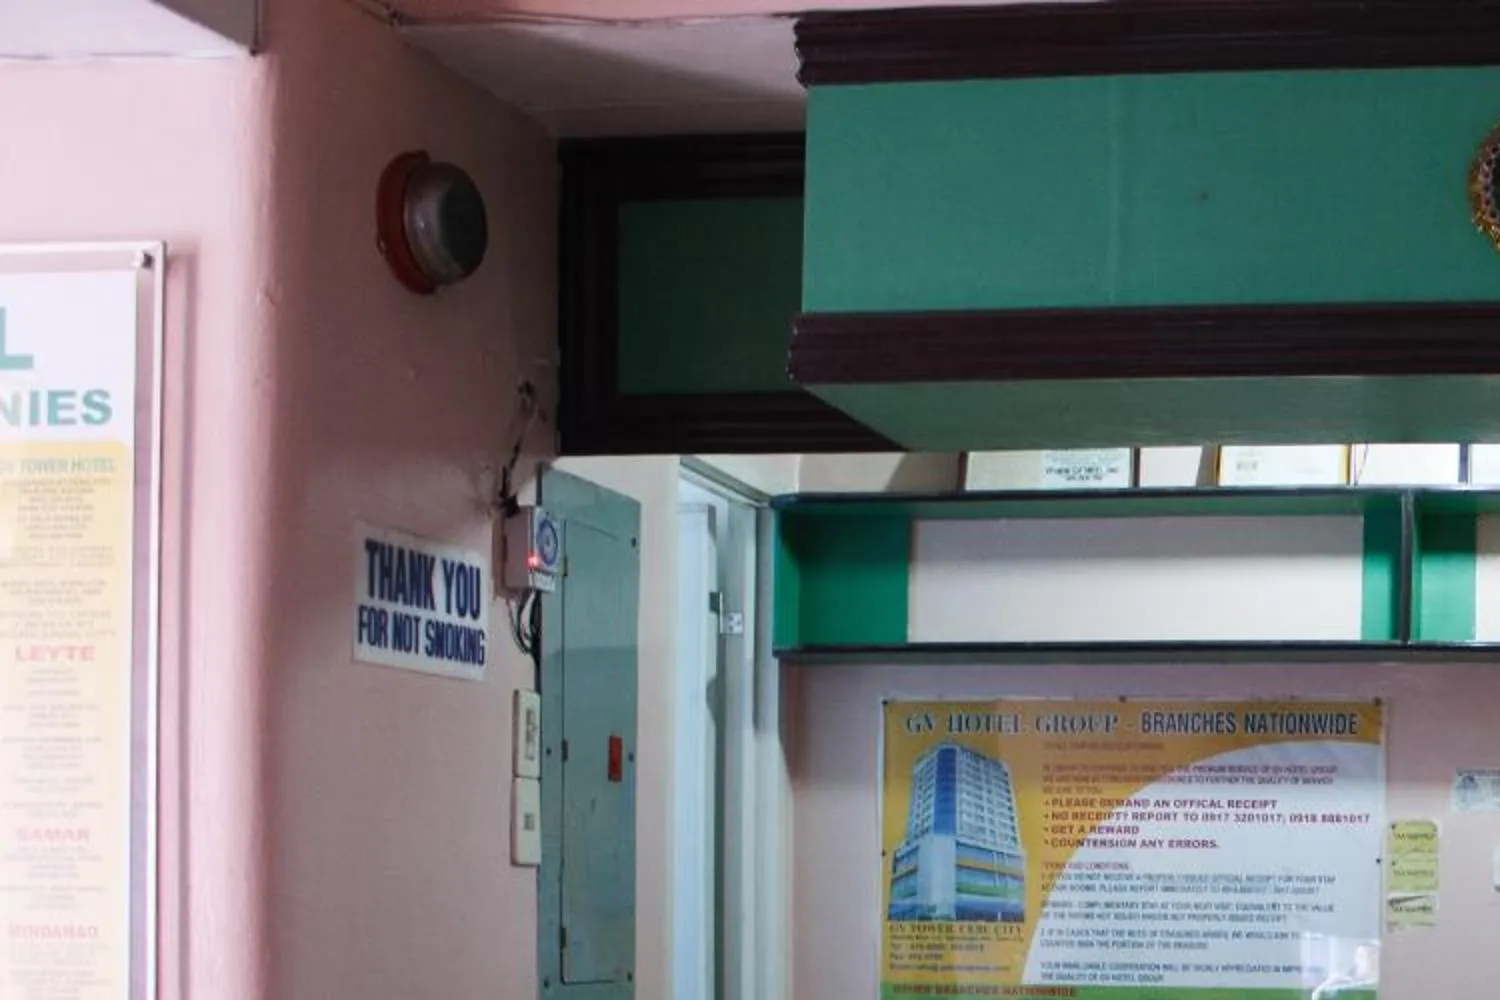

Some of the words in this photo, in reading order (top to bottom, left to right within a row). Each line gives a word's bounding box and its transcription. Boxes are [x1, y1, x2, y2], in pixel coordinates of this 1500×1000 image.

[365, 536, 436, 612] THANK
[441, 557, 481, 621] YOU
[357, 603, 389, 649] FOR
[391, 609, 422, 656] NOT
[424, 617, 486, 667] SMOKING
[14, 644, 96, 662] LEYTE
[905, 712, 935, 735] GV
[948, 712, 1021, 735] HOTEL
[1034, 712, 1119, 735] GROUP
[1141, 712, 1237, 735] BRANCHES
[1244, 712, 1360, 735] NATIONWIDE
[1051, 799, 1097, 808] PLEASE
[1099, 799, 1150, 808] DEMAND
[1153, 799, 1170, 808] AN
[1227, 799, 1278, 808] RECEIPT
[1051, 811, 1069, 822] NO
[1131, 811, 1178, 822] REPORT
[1183, 811, 1198, 822] TO
[1051, 825, 1074, 834] GET
[1077, 825, 1086, 834] A
[1089, 825, 1140, 834] REWARD
[1140, 838, 1164, 848] ANY
